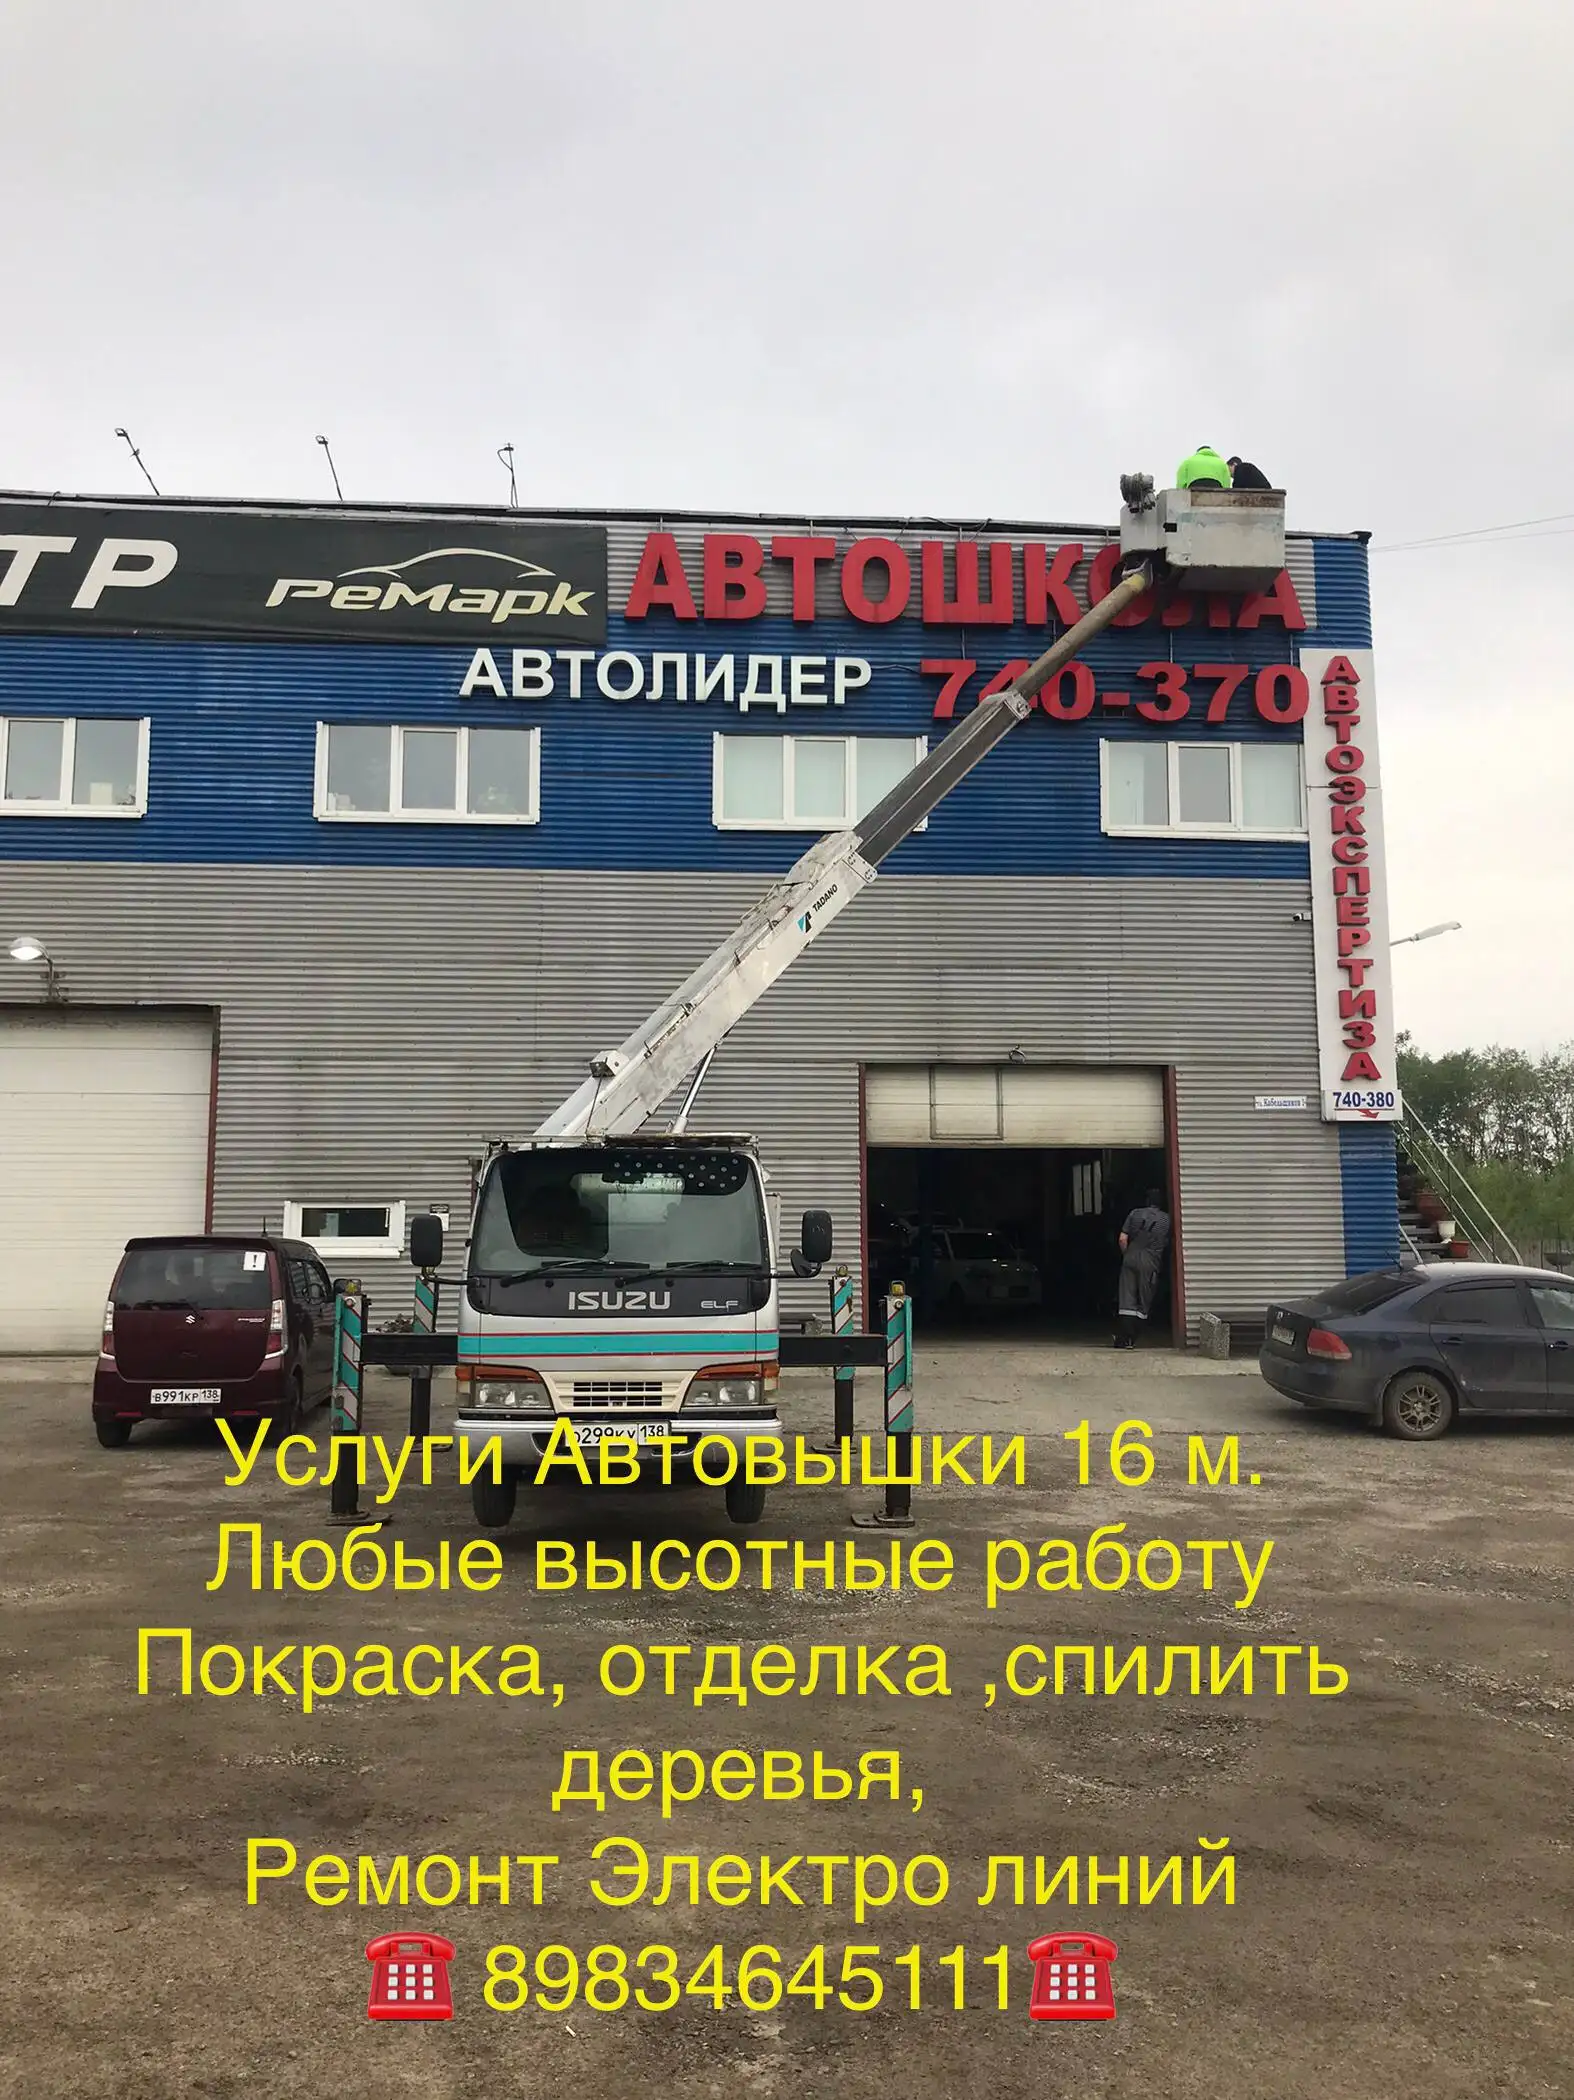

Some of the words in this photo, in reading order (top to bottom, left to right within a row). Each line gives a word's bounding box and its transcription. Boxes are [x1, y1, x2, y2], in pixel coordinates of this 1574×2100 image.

[458, 647, 873, 715] АВТОЛИДЕР
[1320, 655, 1383, 1082] АВТОЭКСПЕРТИЗА
[812, 883, 839, 913] TADANO
[1332, 1091, 1395, 1108] 740-380
[568, 1291, 671, 1310] ISUZU
[701, 1300, 739, 1311] ELF
[640, 1425, 665, 1438] 138
